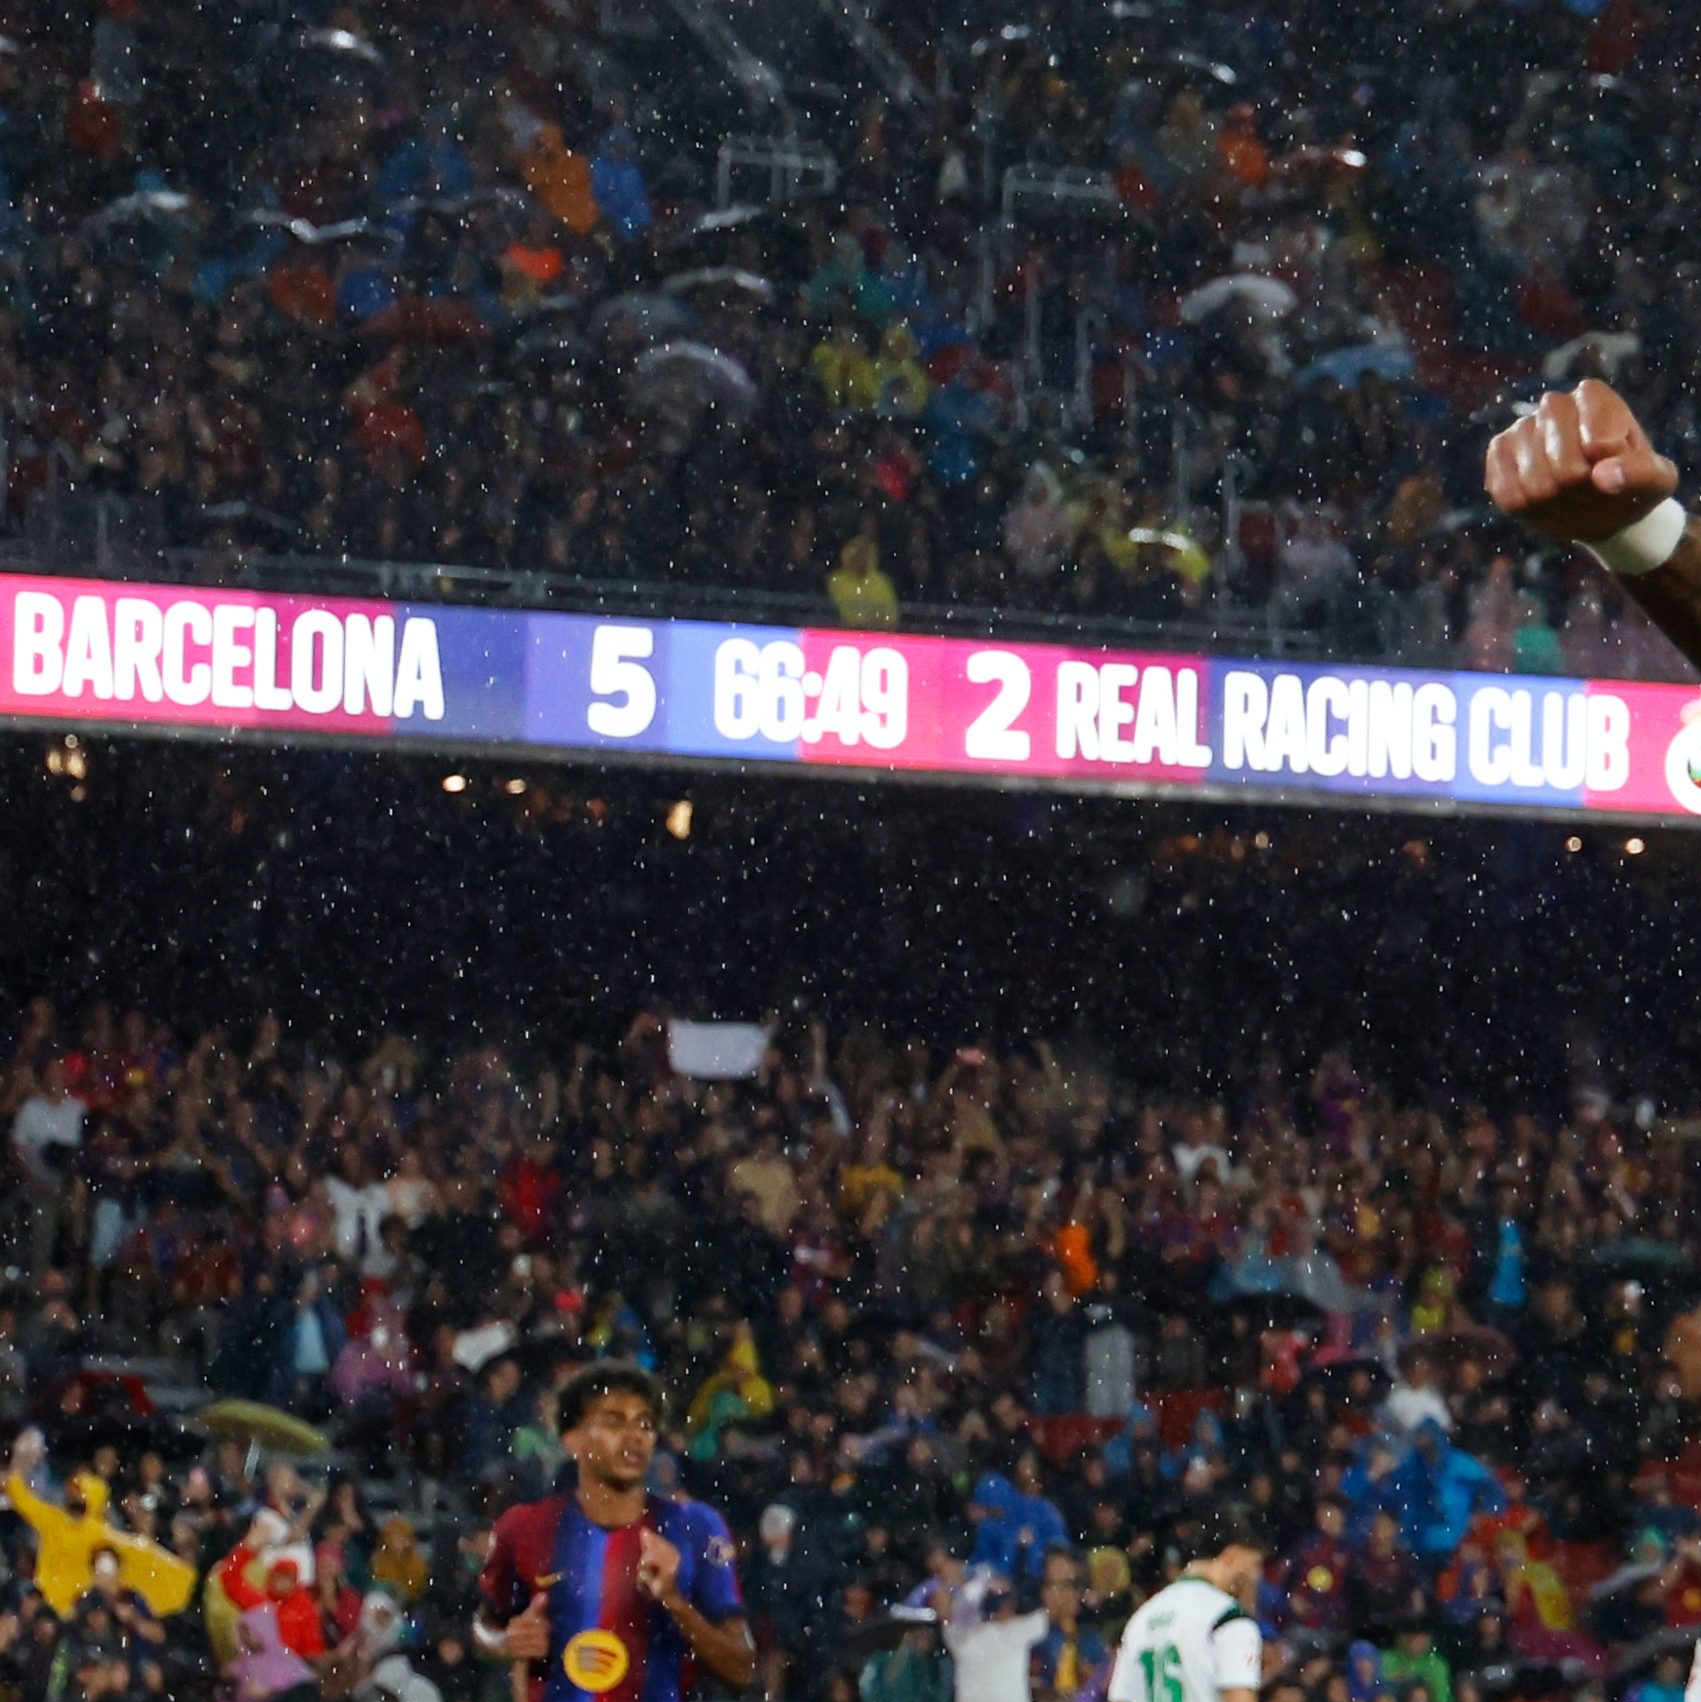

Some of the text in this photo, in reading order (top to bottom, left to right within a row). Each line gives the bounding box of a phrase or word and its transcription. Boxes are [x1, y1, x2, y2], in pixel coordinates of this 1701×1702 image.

[13, 590, 1630, 793] BARCELONA 5 66:49 2 REAL RACING CLUB
